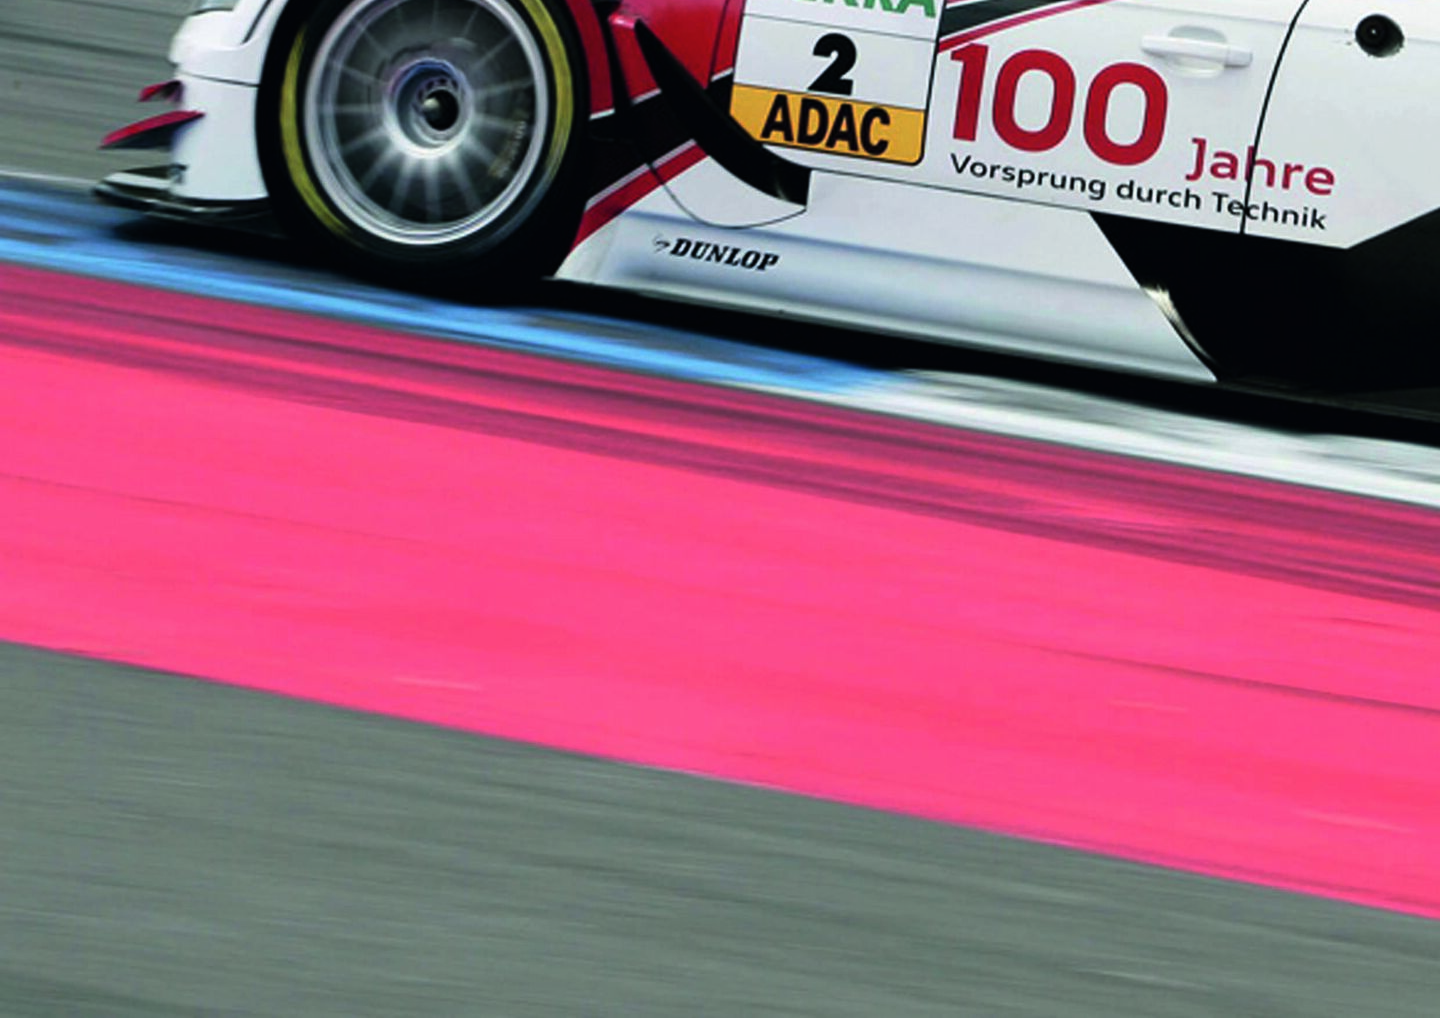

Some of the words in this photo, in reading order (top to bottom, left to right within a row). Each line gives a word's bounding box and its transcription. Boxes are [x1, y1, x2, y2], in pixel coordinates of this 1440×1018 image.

[806, 32, 858, 97] 2
[759, 93, 891, 156] ADAC
[949, 43, 1168, 166] 100
[950, 152, 1107, 201] Vorsprung
[1116, 178, 1201, 211] durch
[1212, 191, 1328, 231] Technik
[1185, 137, 1336, 196] Jahre
[668, 237, 780, 272] DUNLOP
